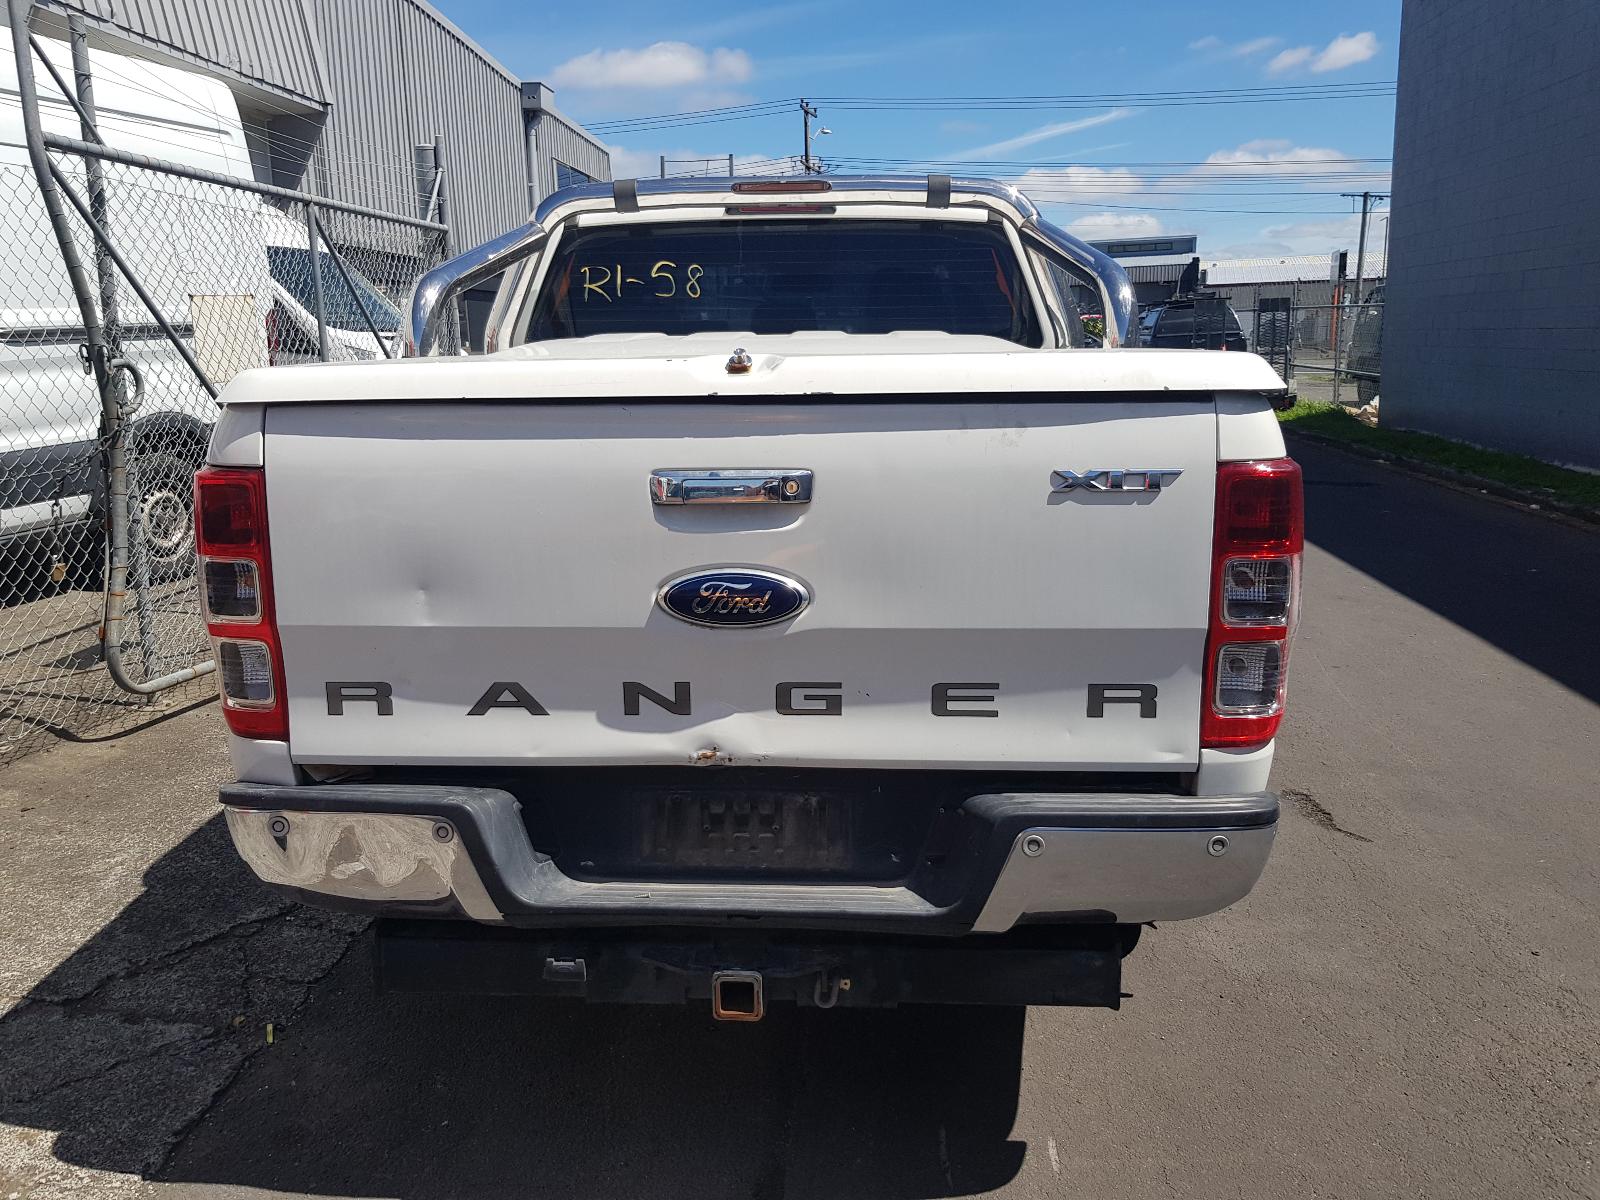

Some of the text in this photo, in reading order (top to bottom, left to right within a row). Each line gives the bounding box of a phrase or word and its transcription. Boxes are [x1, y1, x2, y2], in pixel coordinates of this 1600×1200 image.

[1050, 468, 1185, 492] XLT
[692, 581, 772, 614] Ford
[325, 681, 1158, 718] RANGER
